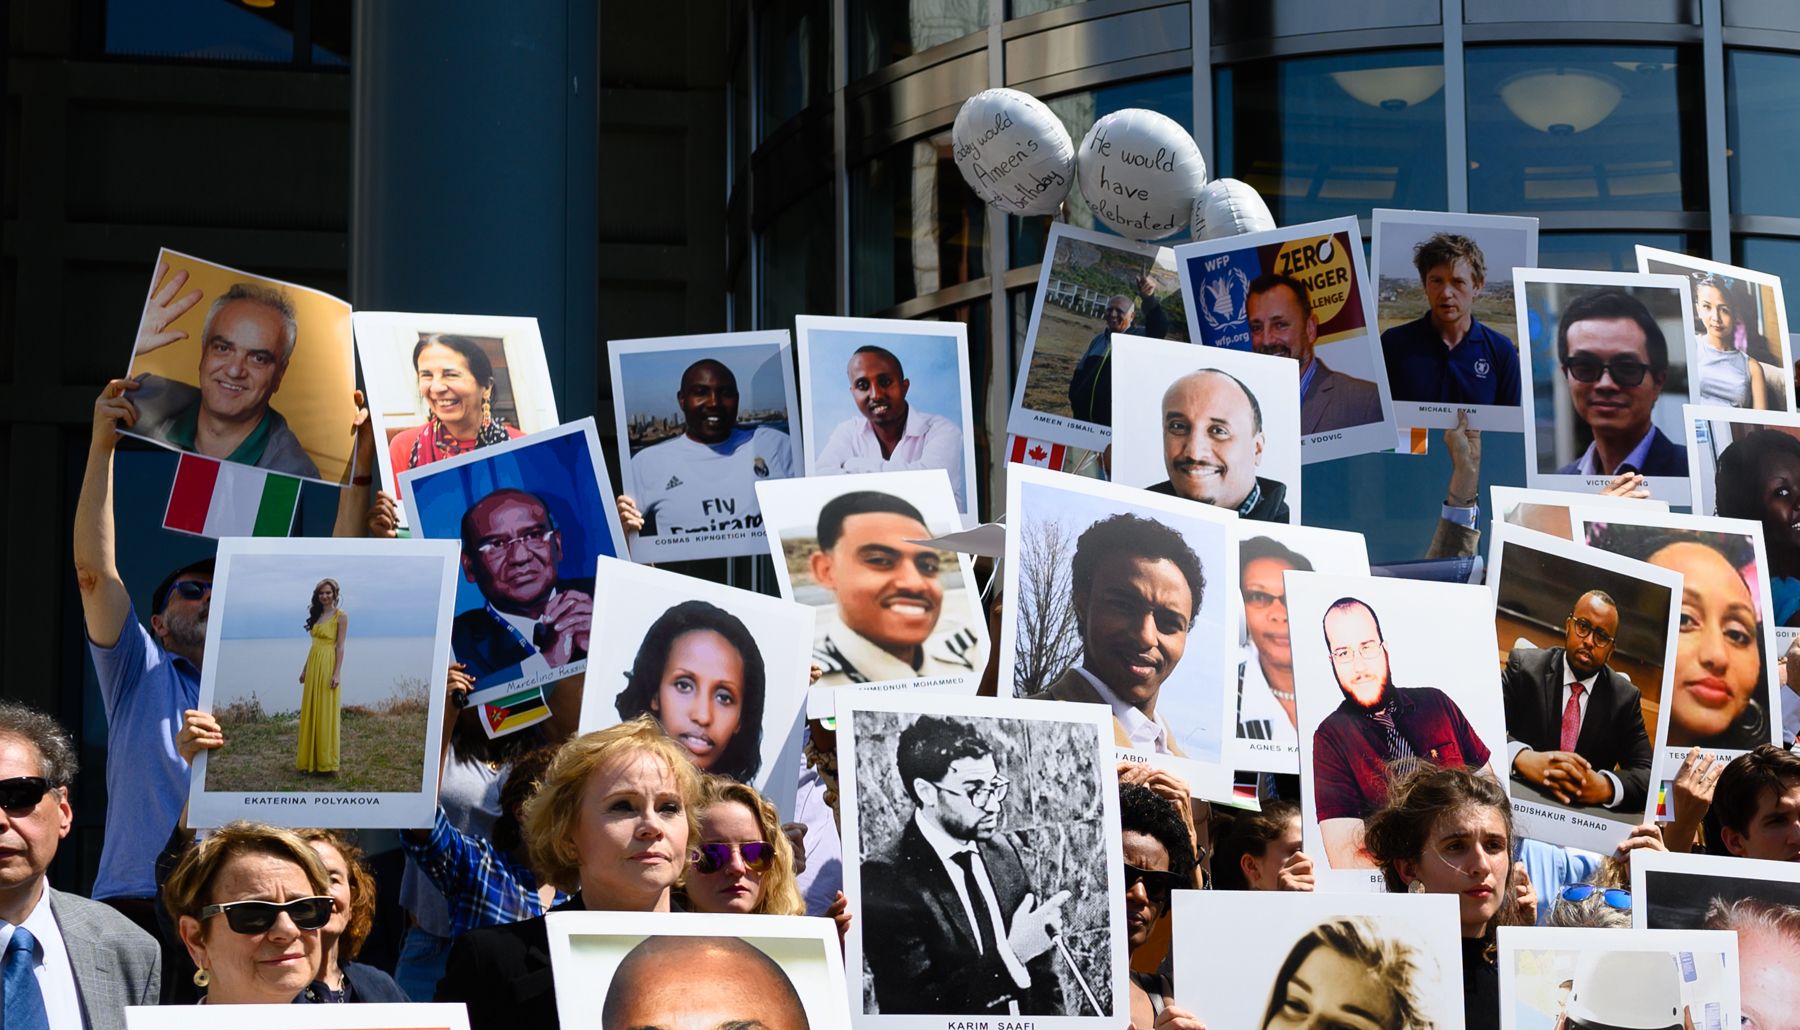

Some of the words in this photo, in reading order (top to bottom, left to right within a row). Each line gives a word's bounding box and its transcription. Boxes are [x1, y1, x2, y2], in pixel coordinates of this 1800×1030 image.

[1090, 127, 1111, 157] He
[1121, 147, 1176, 172] would
[973, 139, 1038, 189] Ameen's
[1002, 171, 1065, 209] birthday
[1100, 165, 1149, 201] have
[1204, 255, 1230, 272] WFP
[1279, 239, 1335, 277] ZERO
[1301, 267, 1348, 292] NGER
[1215, 331, 1249, 348] wfp.org
[1033, 415, 1062, 426] AMEEN
[1067, 422, 1095, 433] ISMAIL
[1311, 433, 1343, 444] VDOVIC
[702, 497, 735, 516] Fly
[655, 537, 690, 546] COSMAS
[913, 678, 964, 688] MOHAMMED
[1250, 743, 1282, 752] AGNES
[244, 797, 307, 806] EKATERINA
[314, 797, 380, 806] POLYAKOVA
[1571, 817, 1608, 832] SHAHAD
[948, 1021, 989, 1030] KARIM
